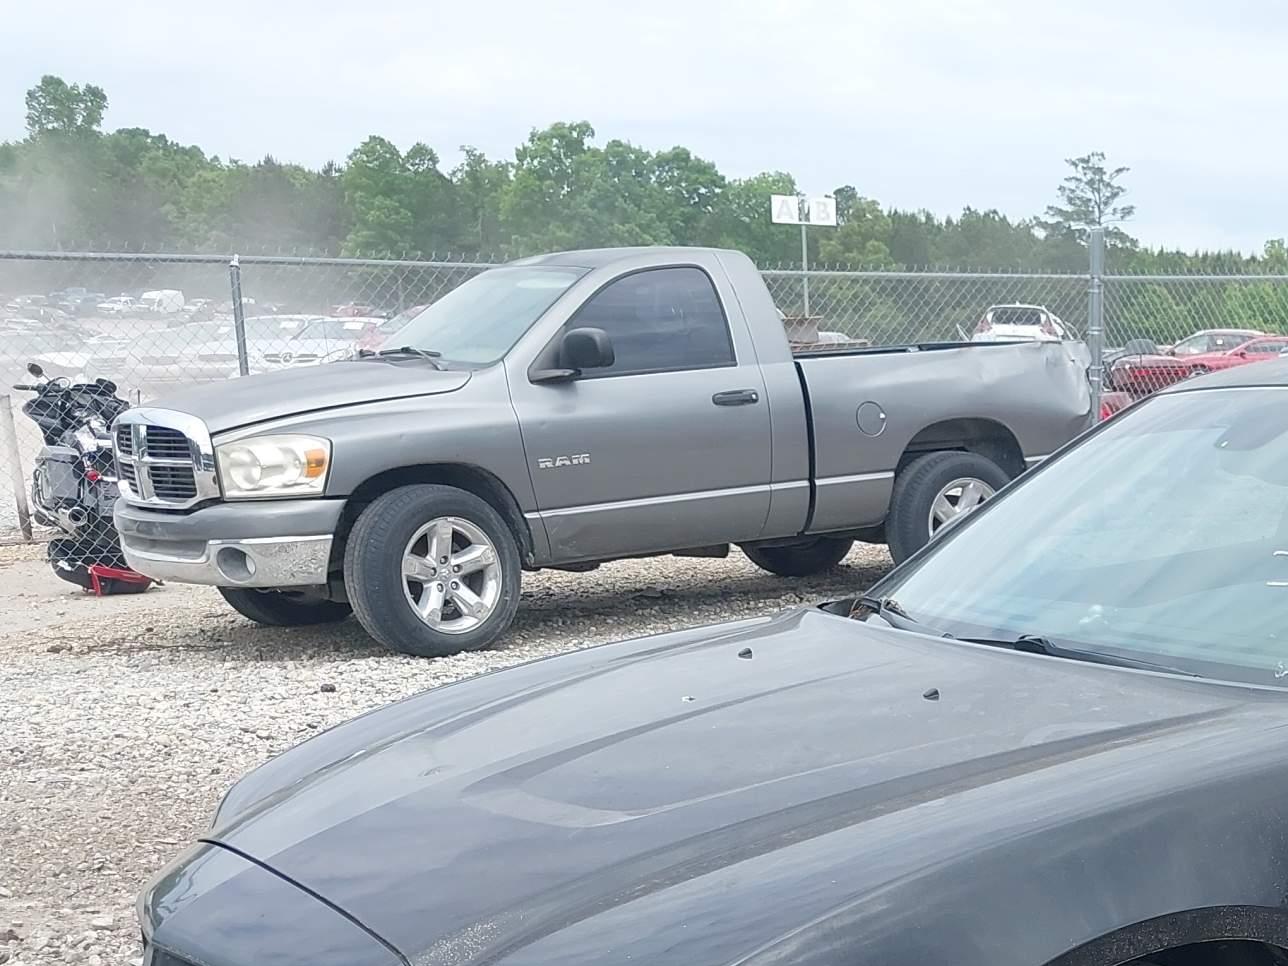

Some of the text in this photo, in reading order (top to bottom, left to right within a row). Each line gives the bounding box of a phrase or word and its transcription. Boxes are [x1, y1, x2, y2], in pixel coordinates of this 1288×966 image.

[776, 199, 831, 221] A B
[537, 453, 591, 469] RAM
